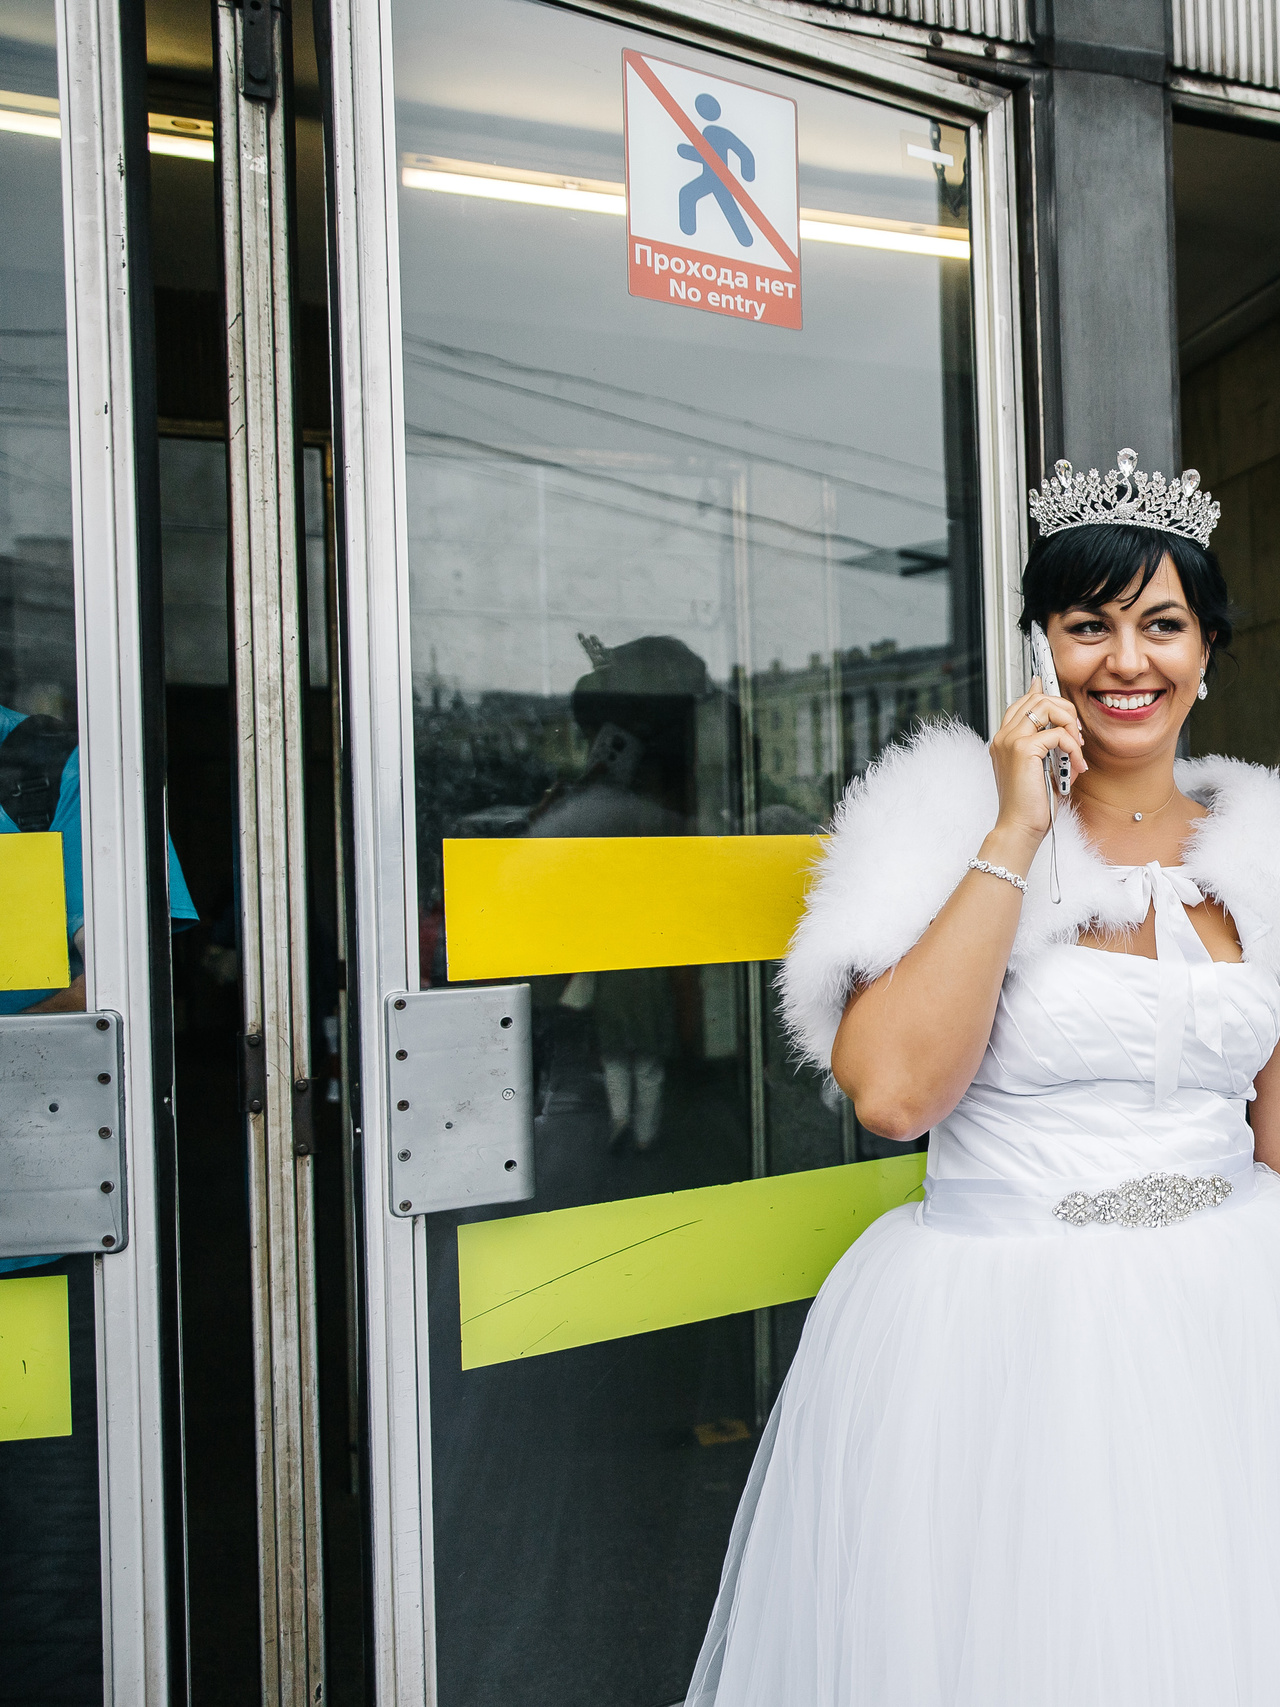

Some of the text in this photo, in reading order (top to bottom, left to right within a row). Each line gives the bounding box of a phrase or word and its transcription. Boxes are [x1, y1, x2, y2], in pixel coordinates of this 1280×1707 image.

[634, 243, 796, 299] Прохода нет
[669, 278, 766, 320] No entry
